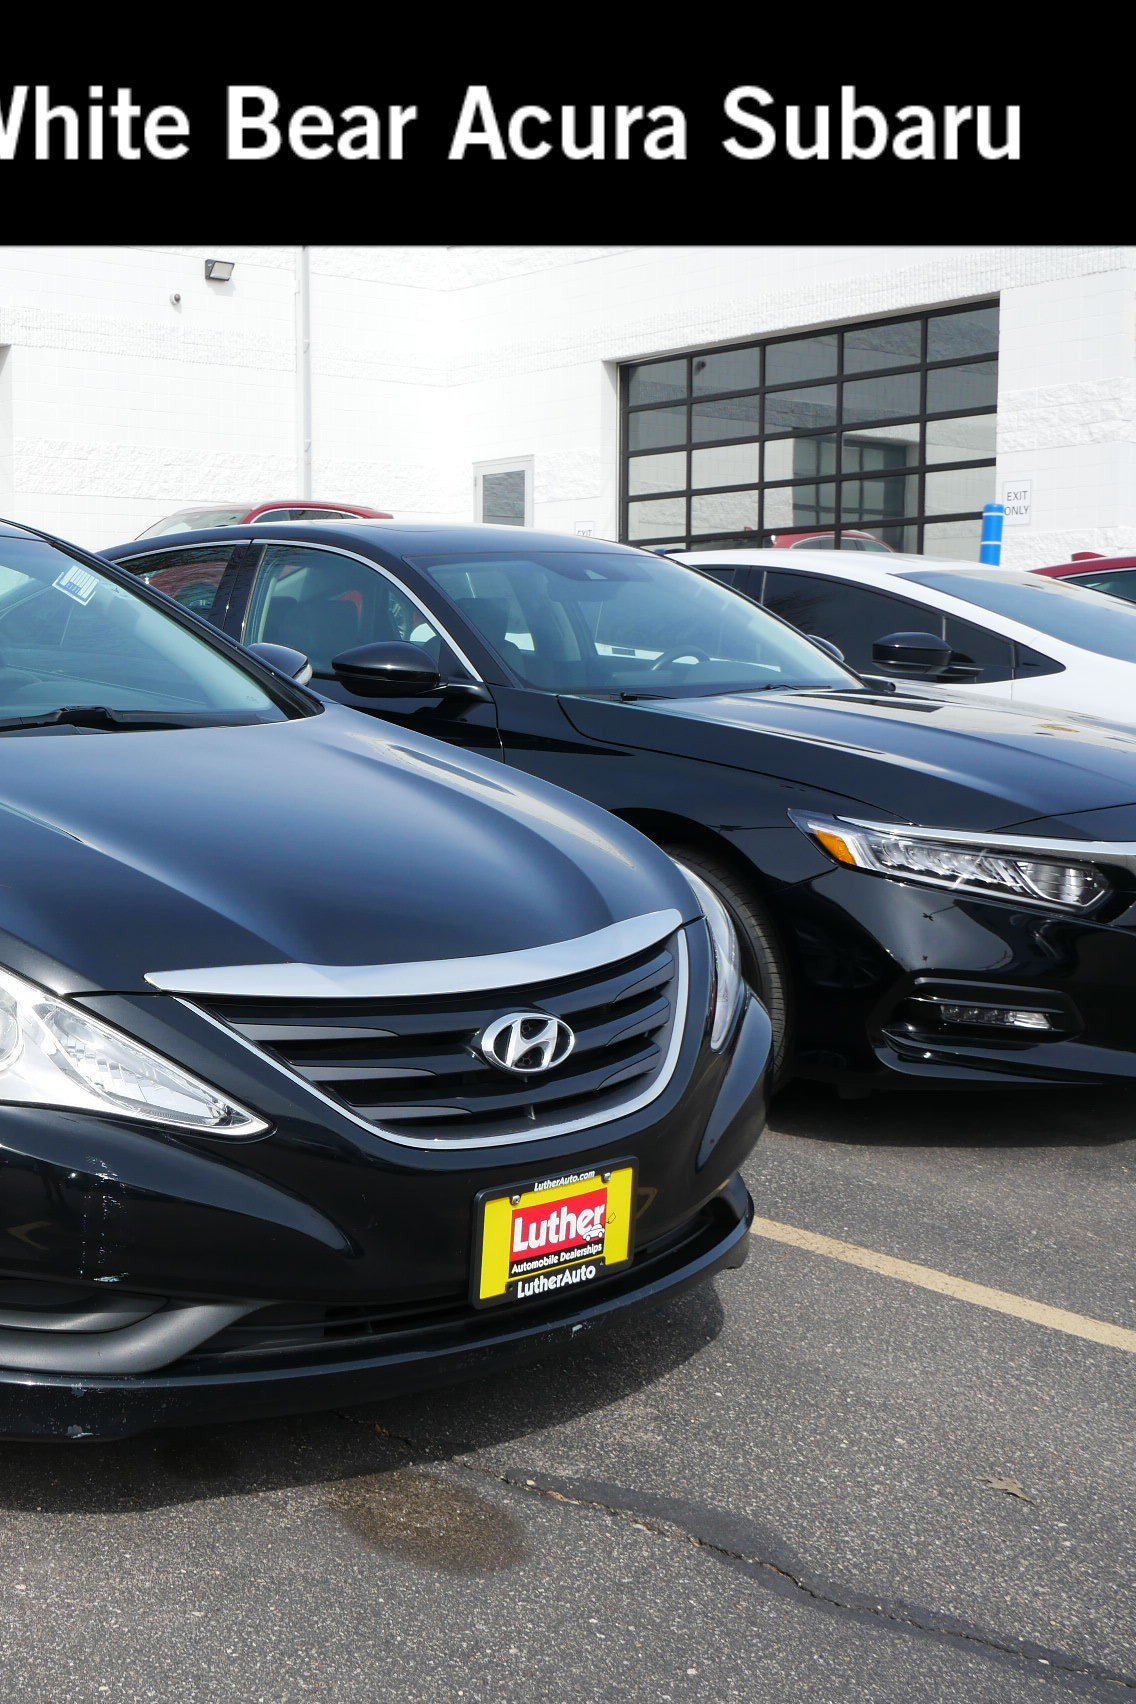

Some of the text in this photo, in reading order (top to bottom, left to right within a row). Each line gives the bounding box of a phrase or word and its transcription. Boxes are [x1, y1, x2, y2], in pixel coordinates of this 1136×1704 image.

[1007, 490, 1029, 501] EXIT
[1004, 505, 1030, 516] ONLY
[534, 1171, 596, 1192] LutherAuto.com
[512, 1204, 606, 1253] Luther
[511, 1243, 602, 1274] Automobile Dealerships
[517, 1265, 596, 1299] LutherAuto
